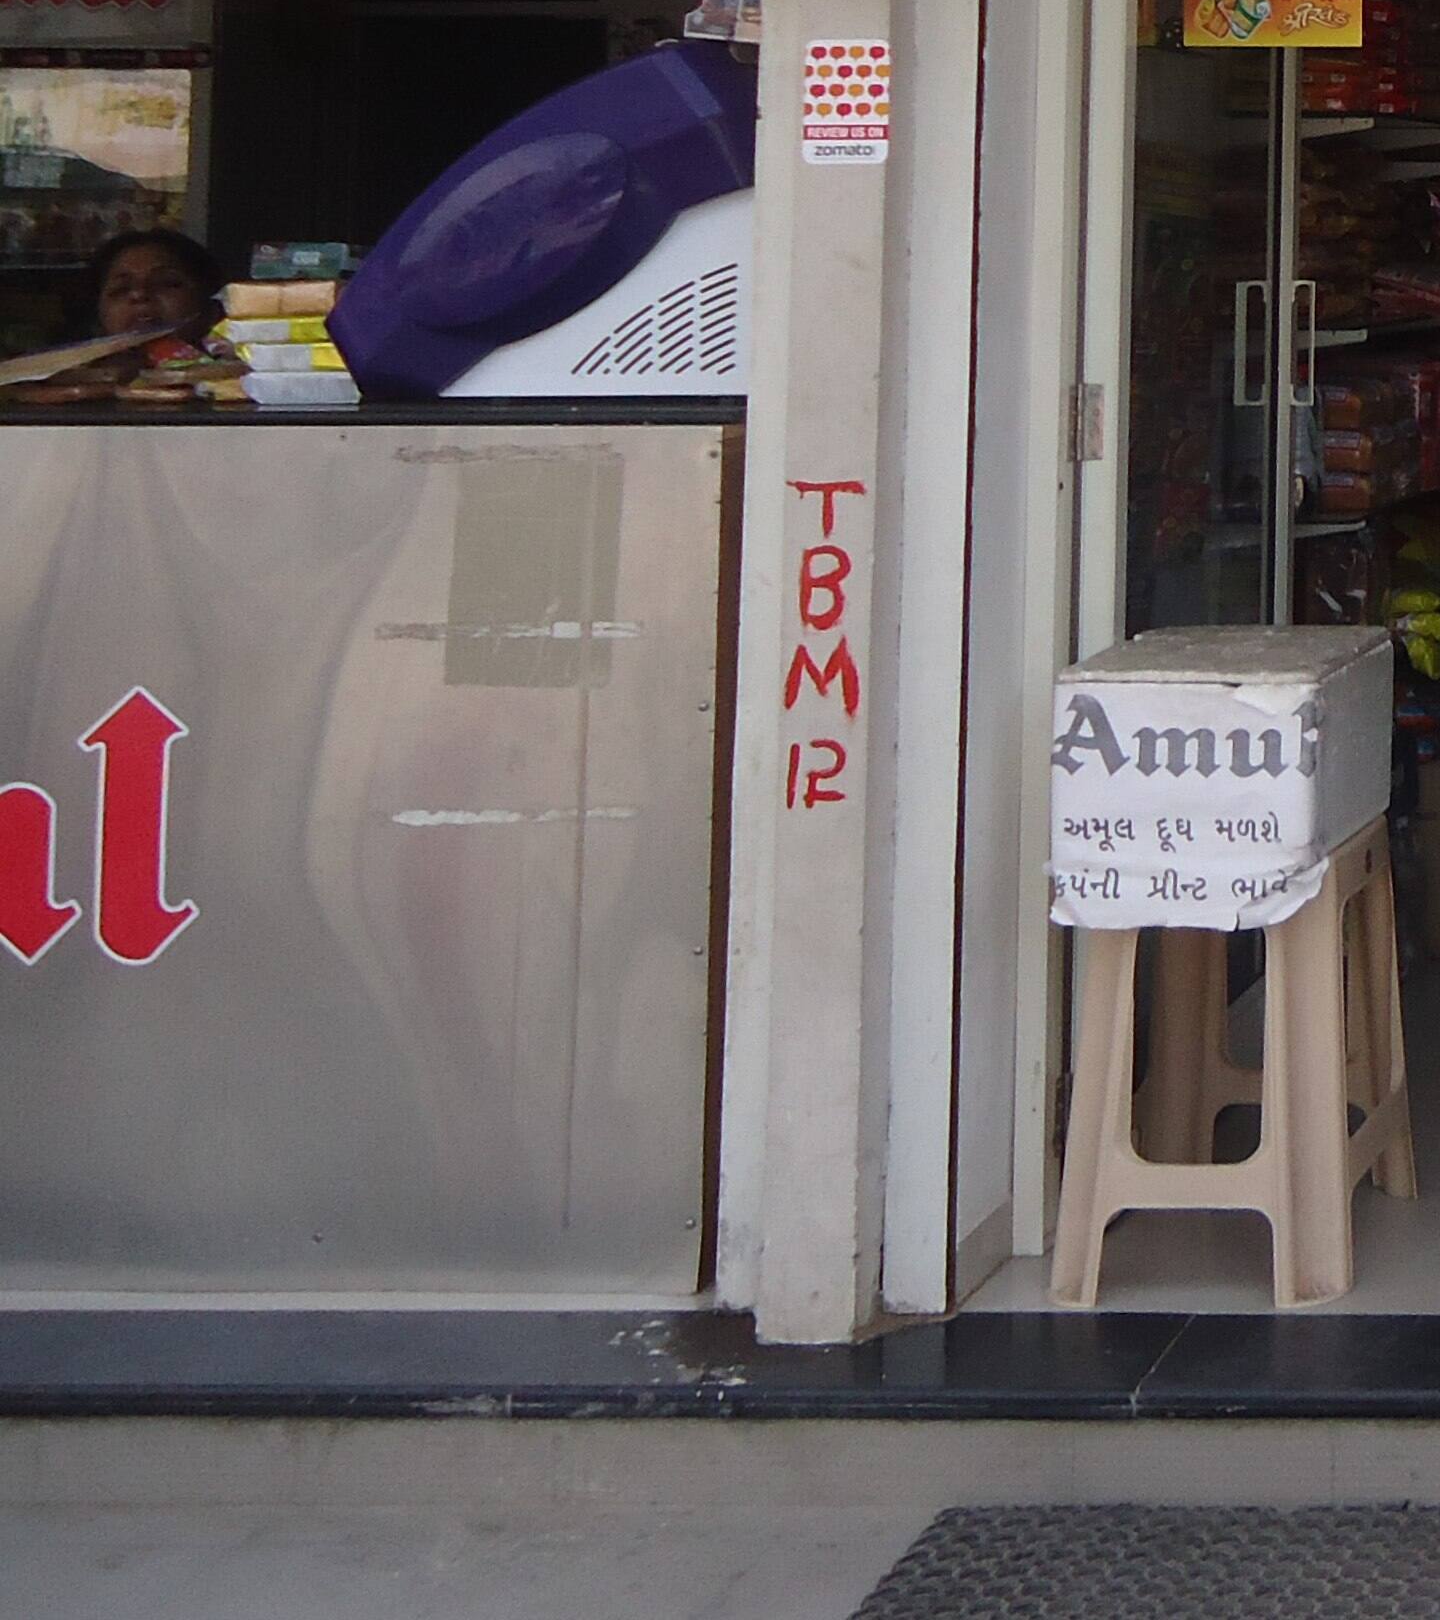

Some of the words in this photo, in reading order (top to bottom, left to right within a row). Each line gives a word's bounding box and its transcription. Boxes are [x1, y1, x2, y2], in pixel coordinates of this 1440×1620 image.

[815, 145, 873, 156] zomato
[1050, 694, 1324, 779] Amul
[1064, 817, 1136, 852] અમૂલ
[1216, 812, 1281, 843] મળશે
[1147, 869, 1208, 900] પ્રીન્ટ
[1232, 869, 1289, 901] ભાવે
